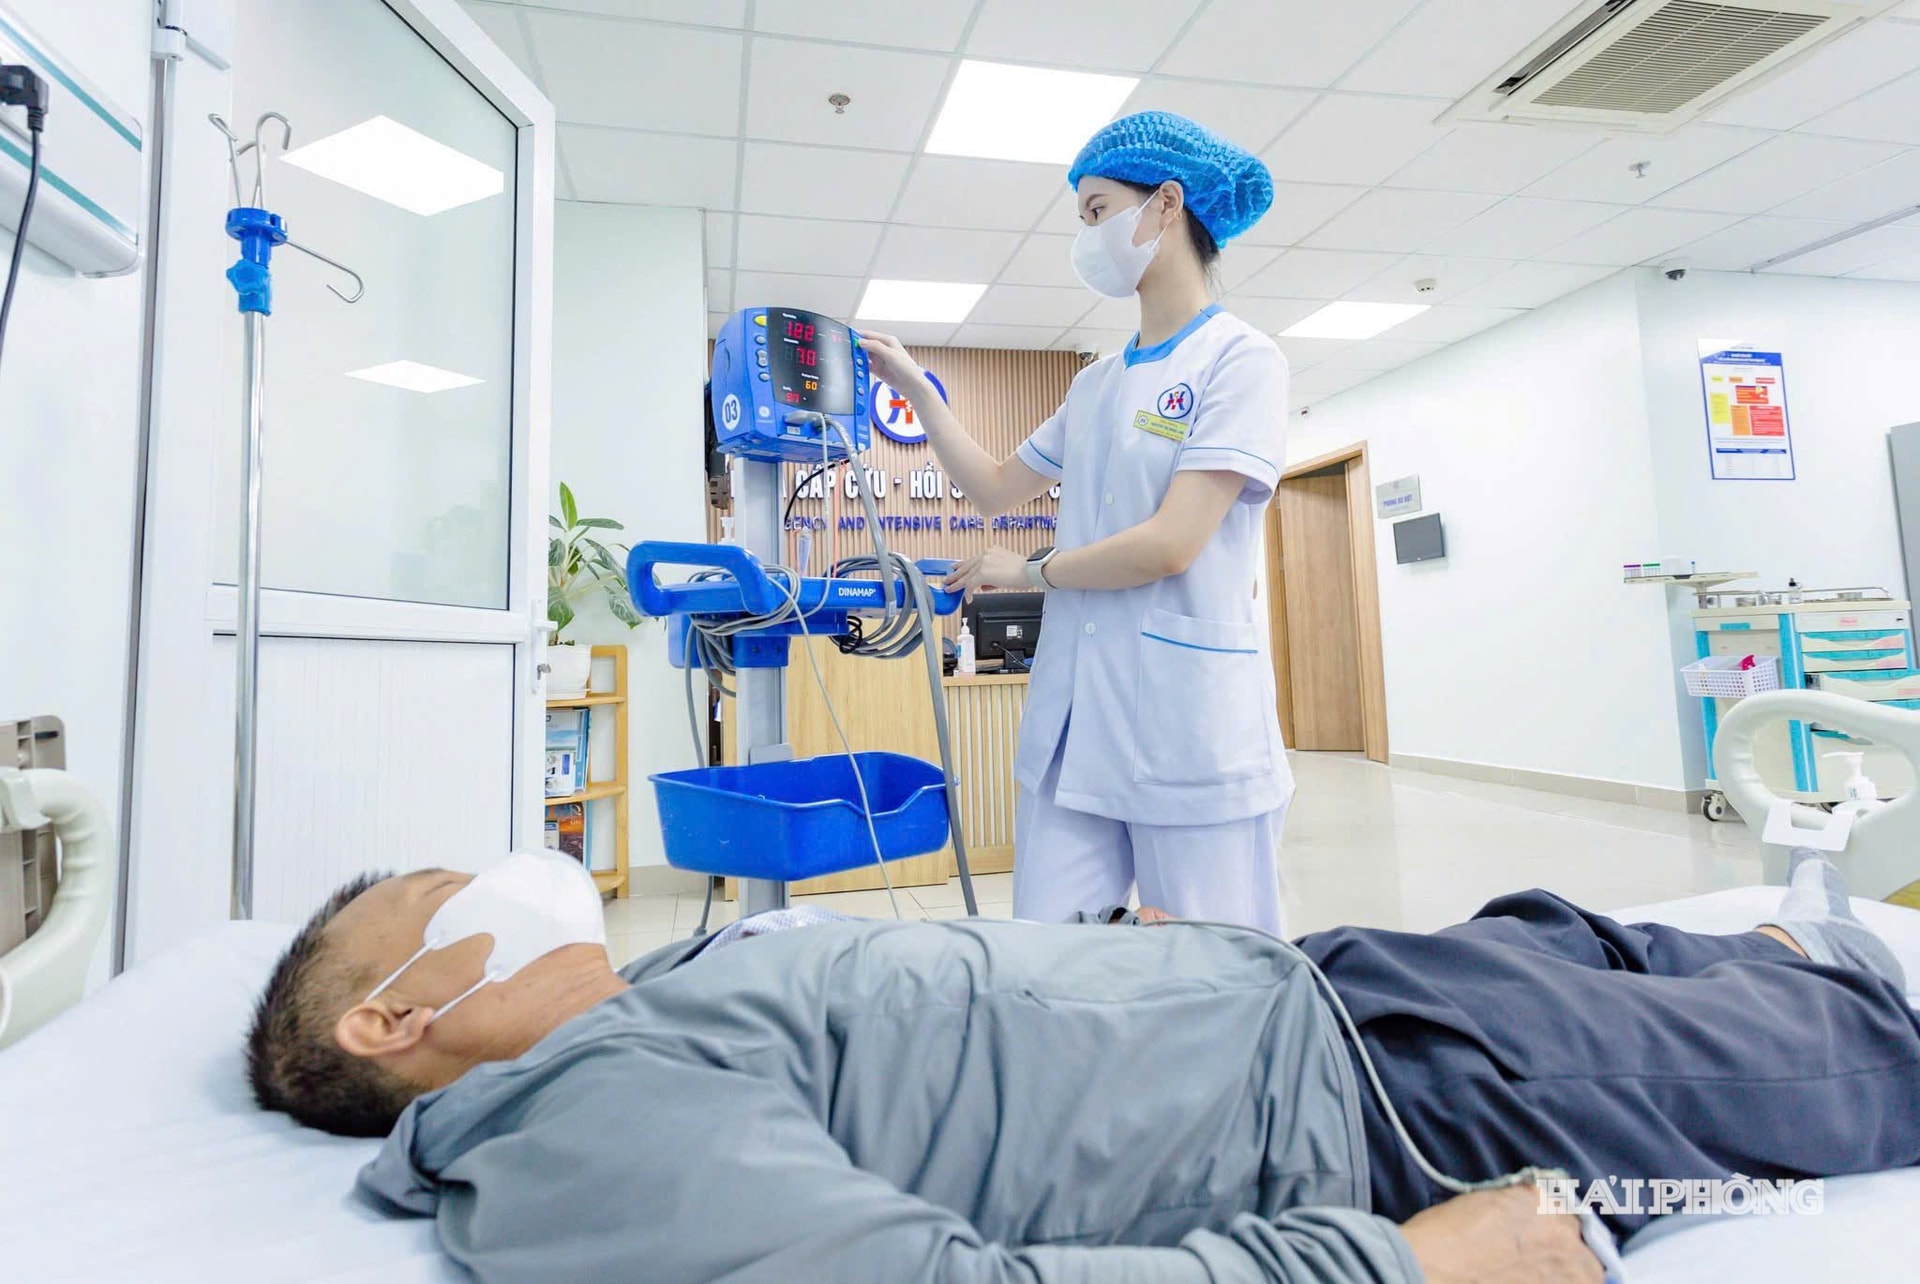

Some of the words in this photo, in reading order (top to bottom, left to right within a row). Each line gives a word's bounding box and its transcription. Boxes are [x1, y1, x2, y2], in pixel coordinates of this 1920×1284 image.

[786, 321, 816, 341] 122
[796, 347, 817, 367] 70
[805, 380, 818, 391] 60
[724, 399, 739, 424] 03
[910, 461, 943, 498] HỒI
[838, 516, 865, 530] AND
[949, 516, 984, 530] CARE
[838, 587, 873, 597] DINAMAP
